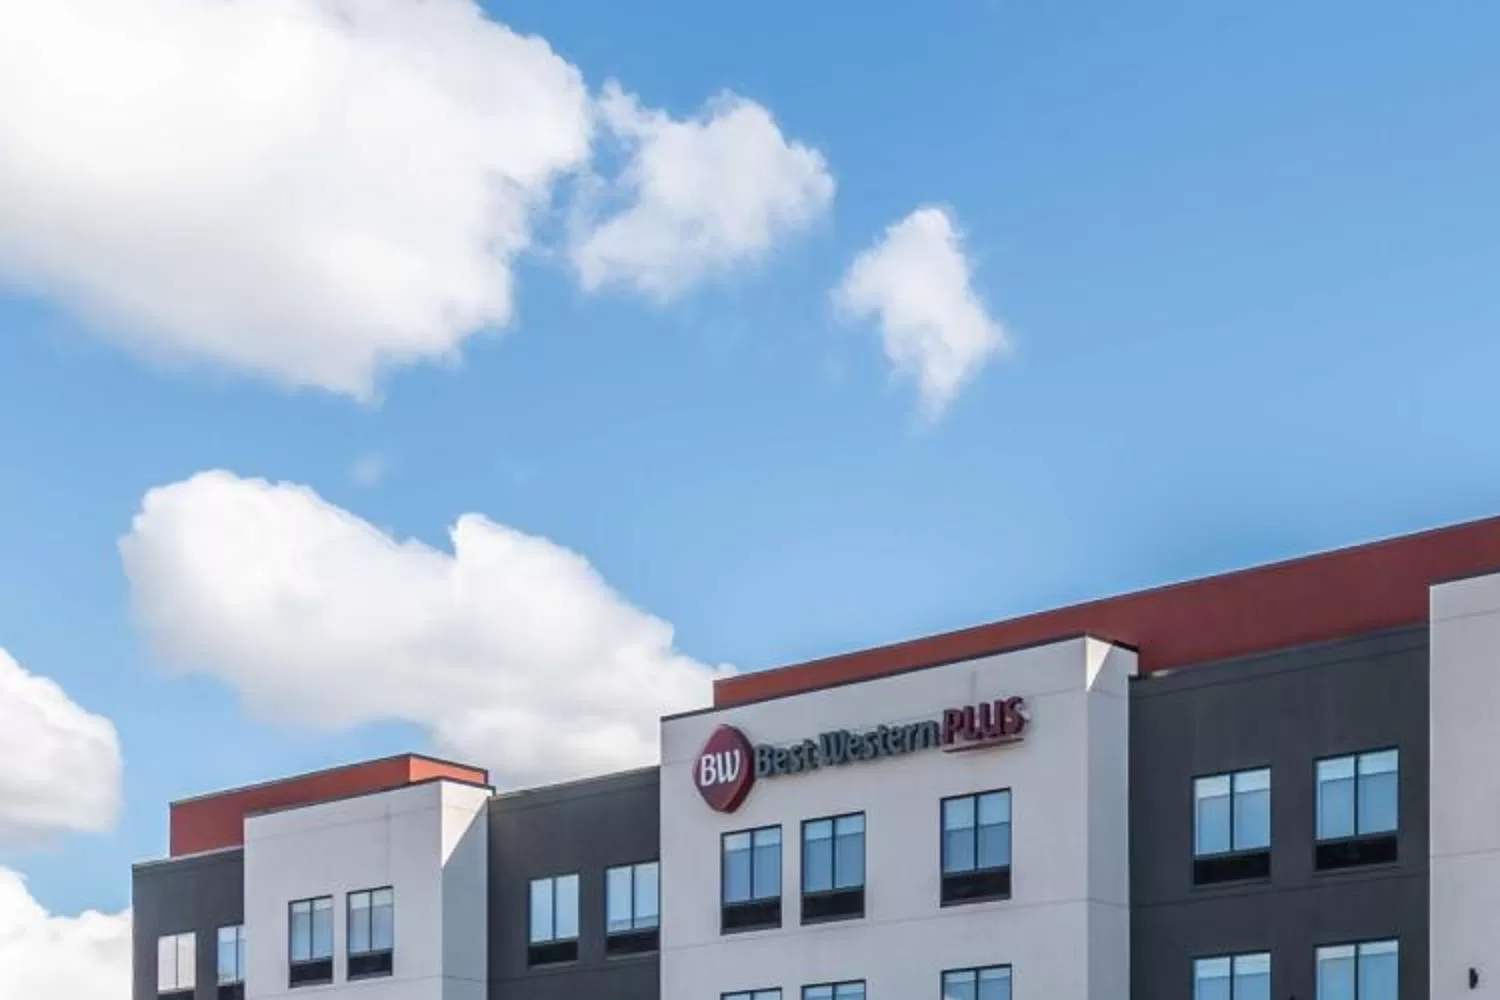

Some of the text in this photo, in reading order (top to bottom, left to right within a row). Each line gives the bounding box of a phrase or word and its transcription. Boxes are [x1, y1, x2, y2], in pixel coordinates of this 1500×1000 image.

[756, 696, 1027, 777] Best Western PLUS
[699, 749, 741, 786] BW
